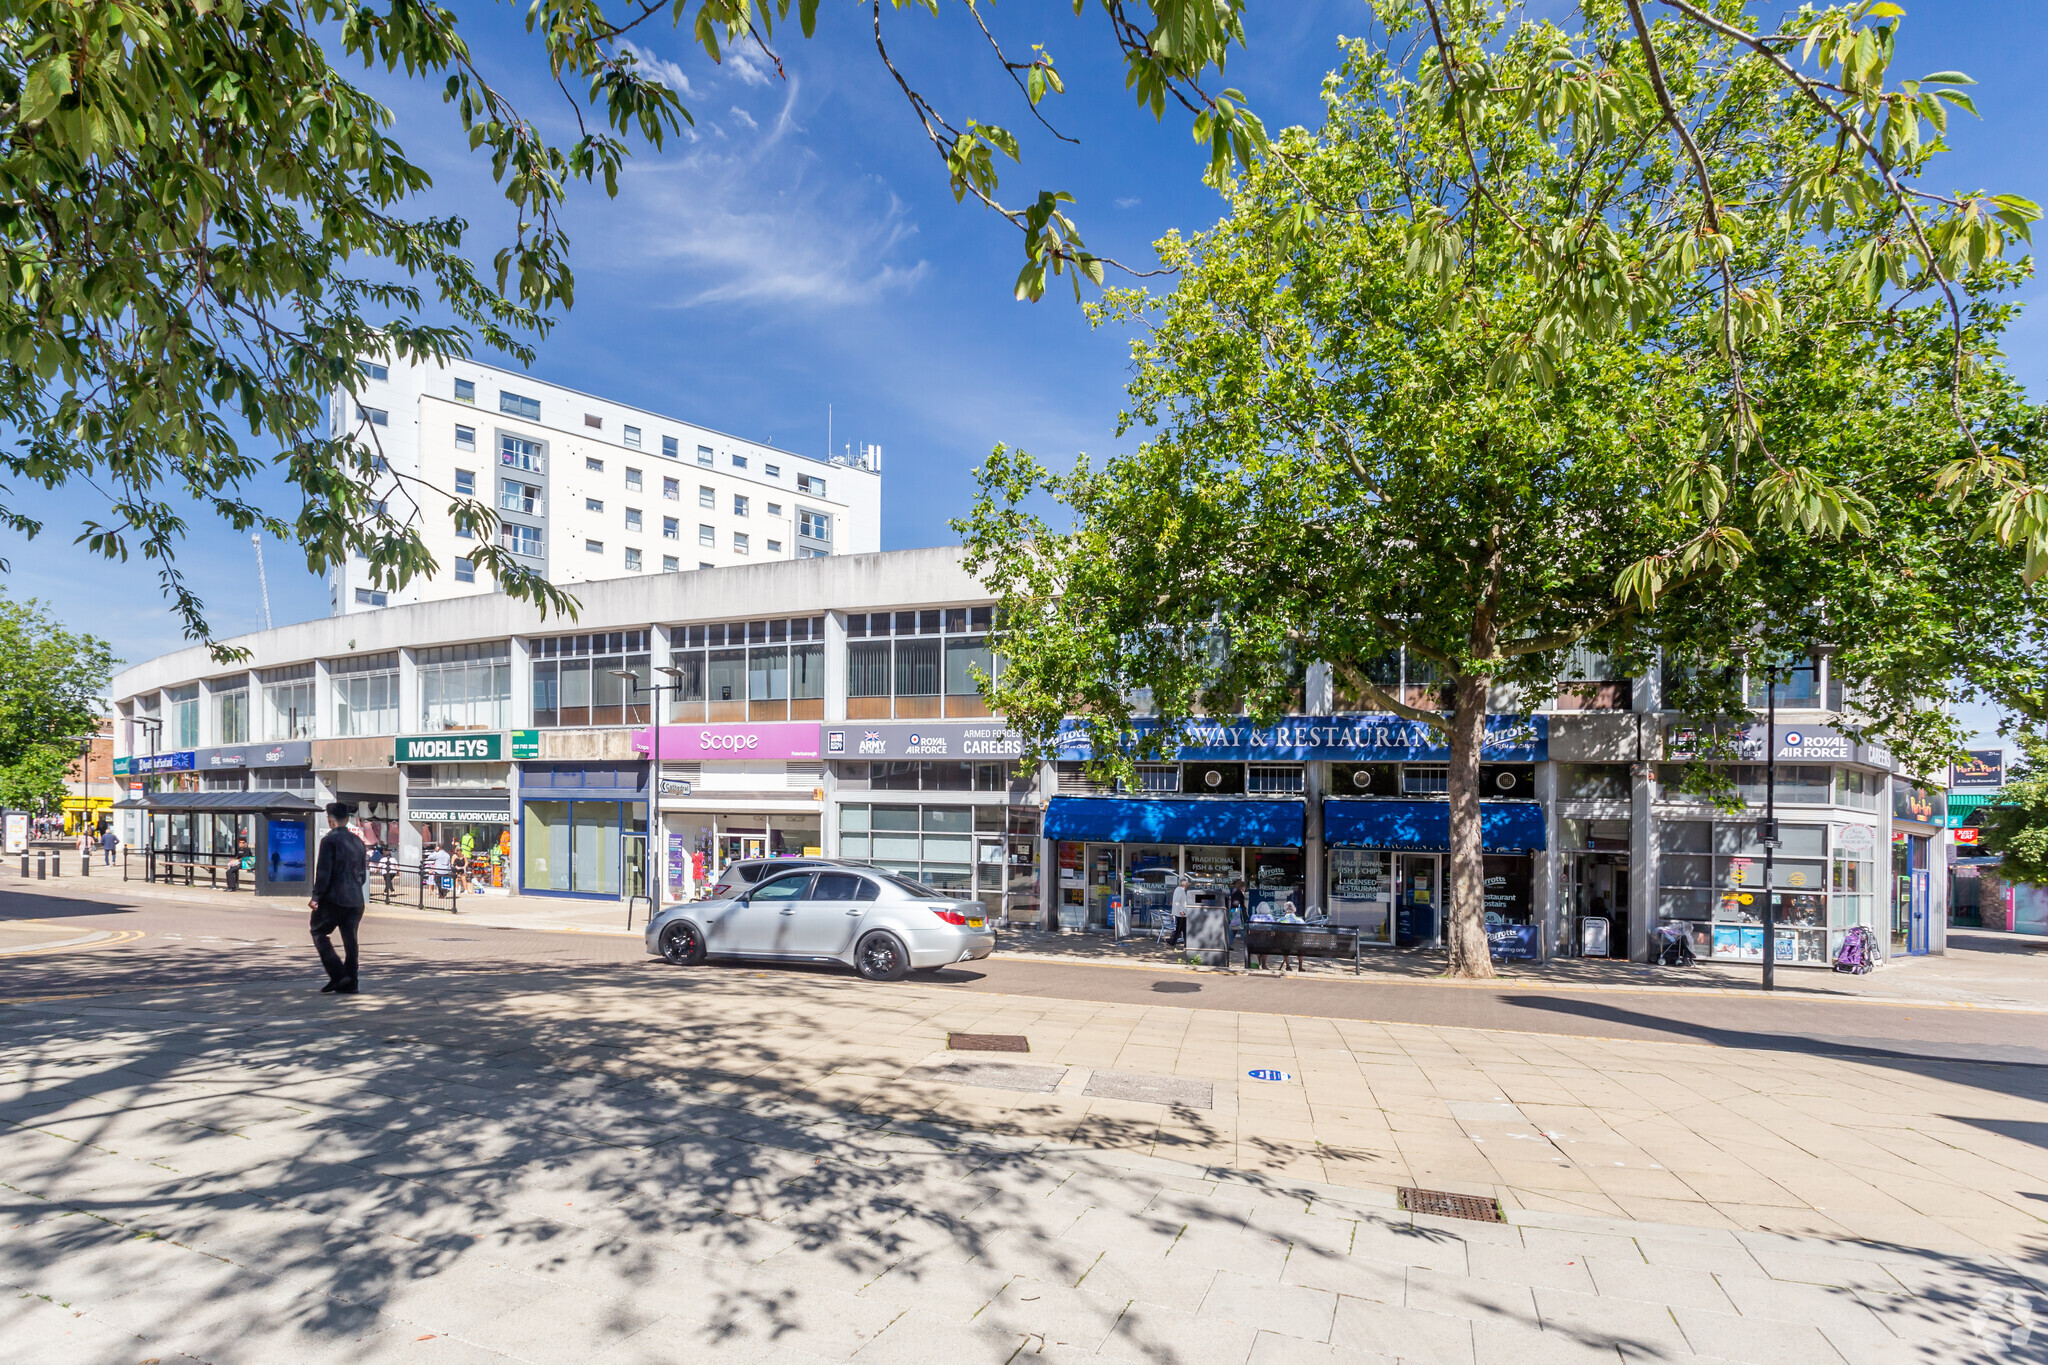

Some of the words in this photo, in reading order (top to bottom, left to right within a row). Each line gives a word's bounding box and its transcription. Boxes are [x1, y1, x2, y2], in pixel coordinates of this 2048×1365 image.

[700, 731, 758, 752] Scope
[1250, 729, 1268, 747] &
[1804, 737, 1848, 747] ROYAL
[408, 740, 488, 757] MORLEYS
[859, 741, 886, 750] ARMY
[905, 746, 919, 754] AIR
[920, 746, 947, 754] FORCE
[963, 741, 1021, 754] CAREERS
[1777, 748, 1802, 757] AIR
[1804, 748, 1848, 757] FORCE
[1868, 745, 1891, 768] CAREERS
[1956, 764, 2000, 774] Peri-Peri
[666, 783, 689, 792] Cathedral
[410, 811, 448, 820] OUTDOOR
[449, 812, 457, 820] &
[459, 812, 510, 821] WORKWEAR
[1258, 868, 1284, 878] Parrotts
[1487, 930, 1517, 941] Parrotts
